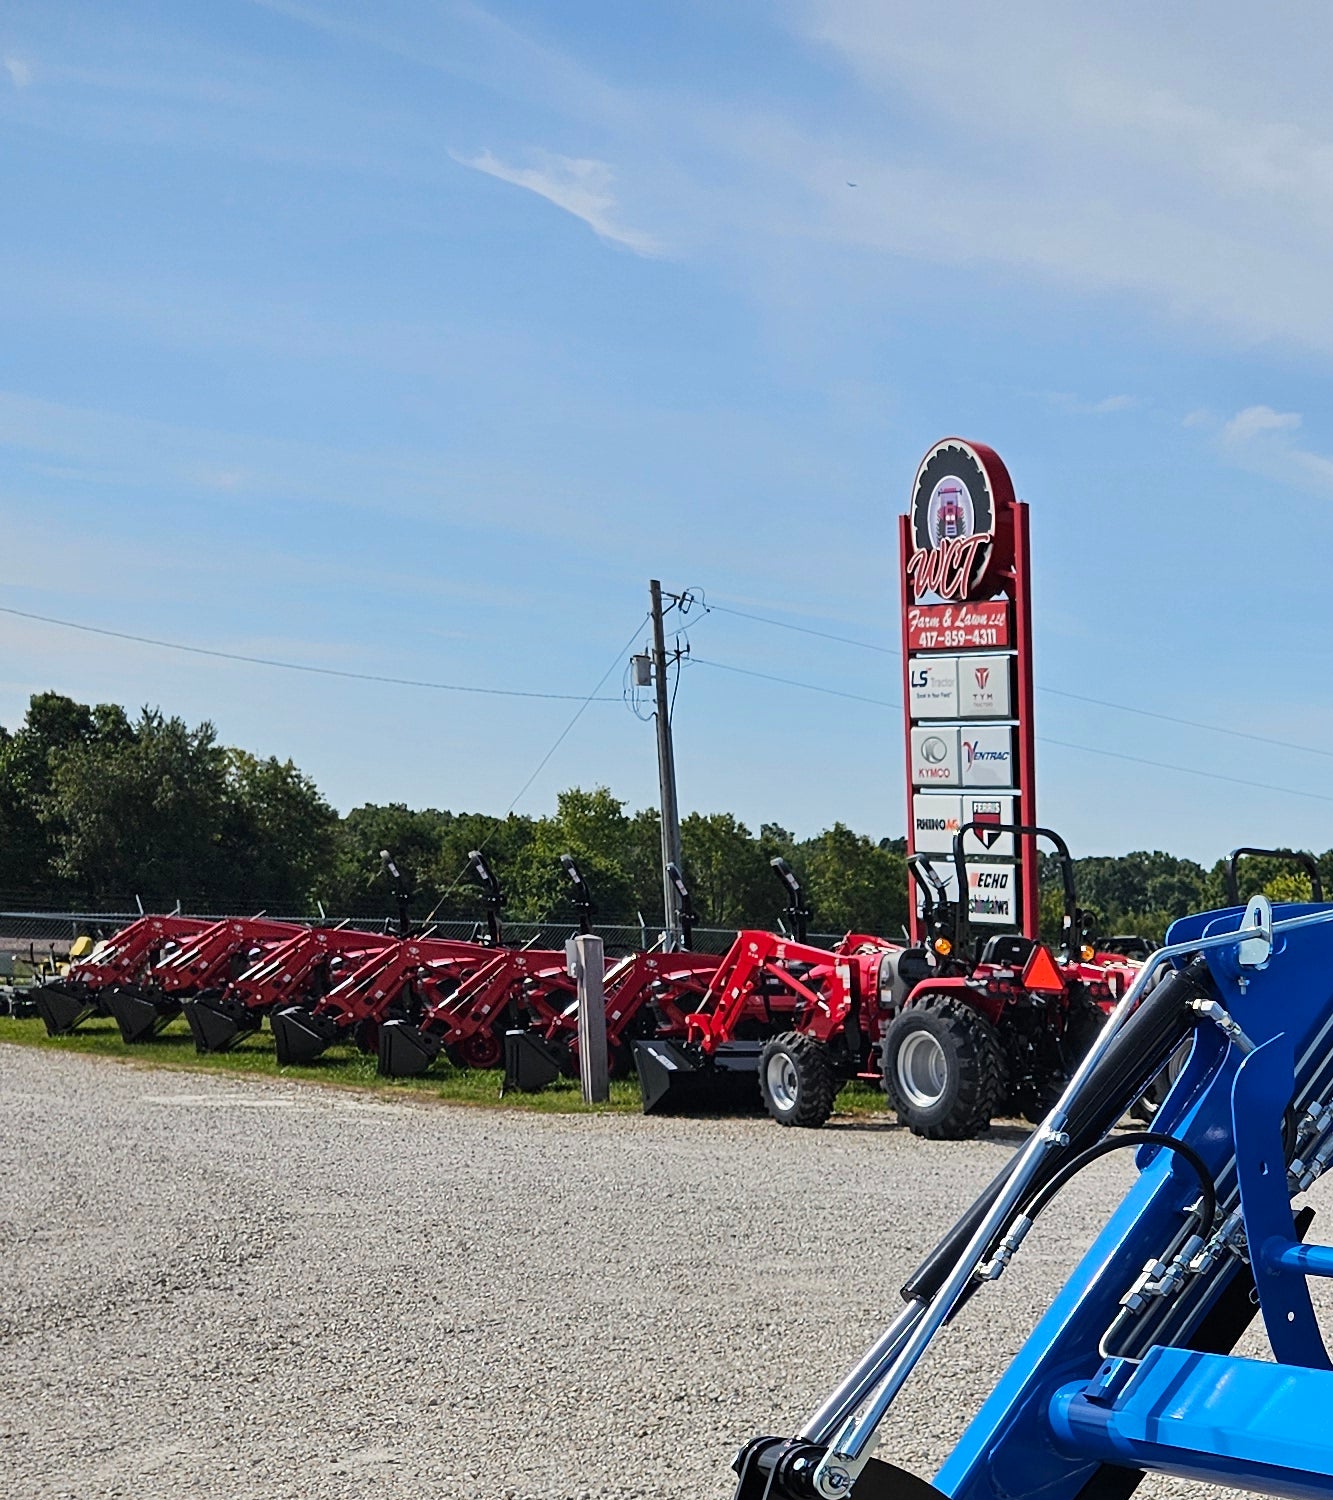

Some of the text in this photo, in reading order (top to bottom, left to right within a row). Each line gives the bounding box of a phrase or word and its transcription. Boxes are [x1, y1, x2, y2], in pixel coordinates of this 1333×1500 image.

[907, 533, 990, 599] WCT
[908, 609, 940, 632] Farm
[942, 607, 952, 628] &
[954, 606, 988, 628] Lawn
[919, 628, 997, 648] 417-859-4311
[911, 670, 928, 688] LS
[963, 741, 1009, 769] VENTRAC
[918, 768, 950, 778] KYMCO
[973, 802, 1001, 814] FERRIS
[977, 873, 1009, 889] ECHO
